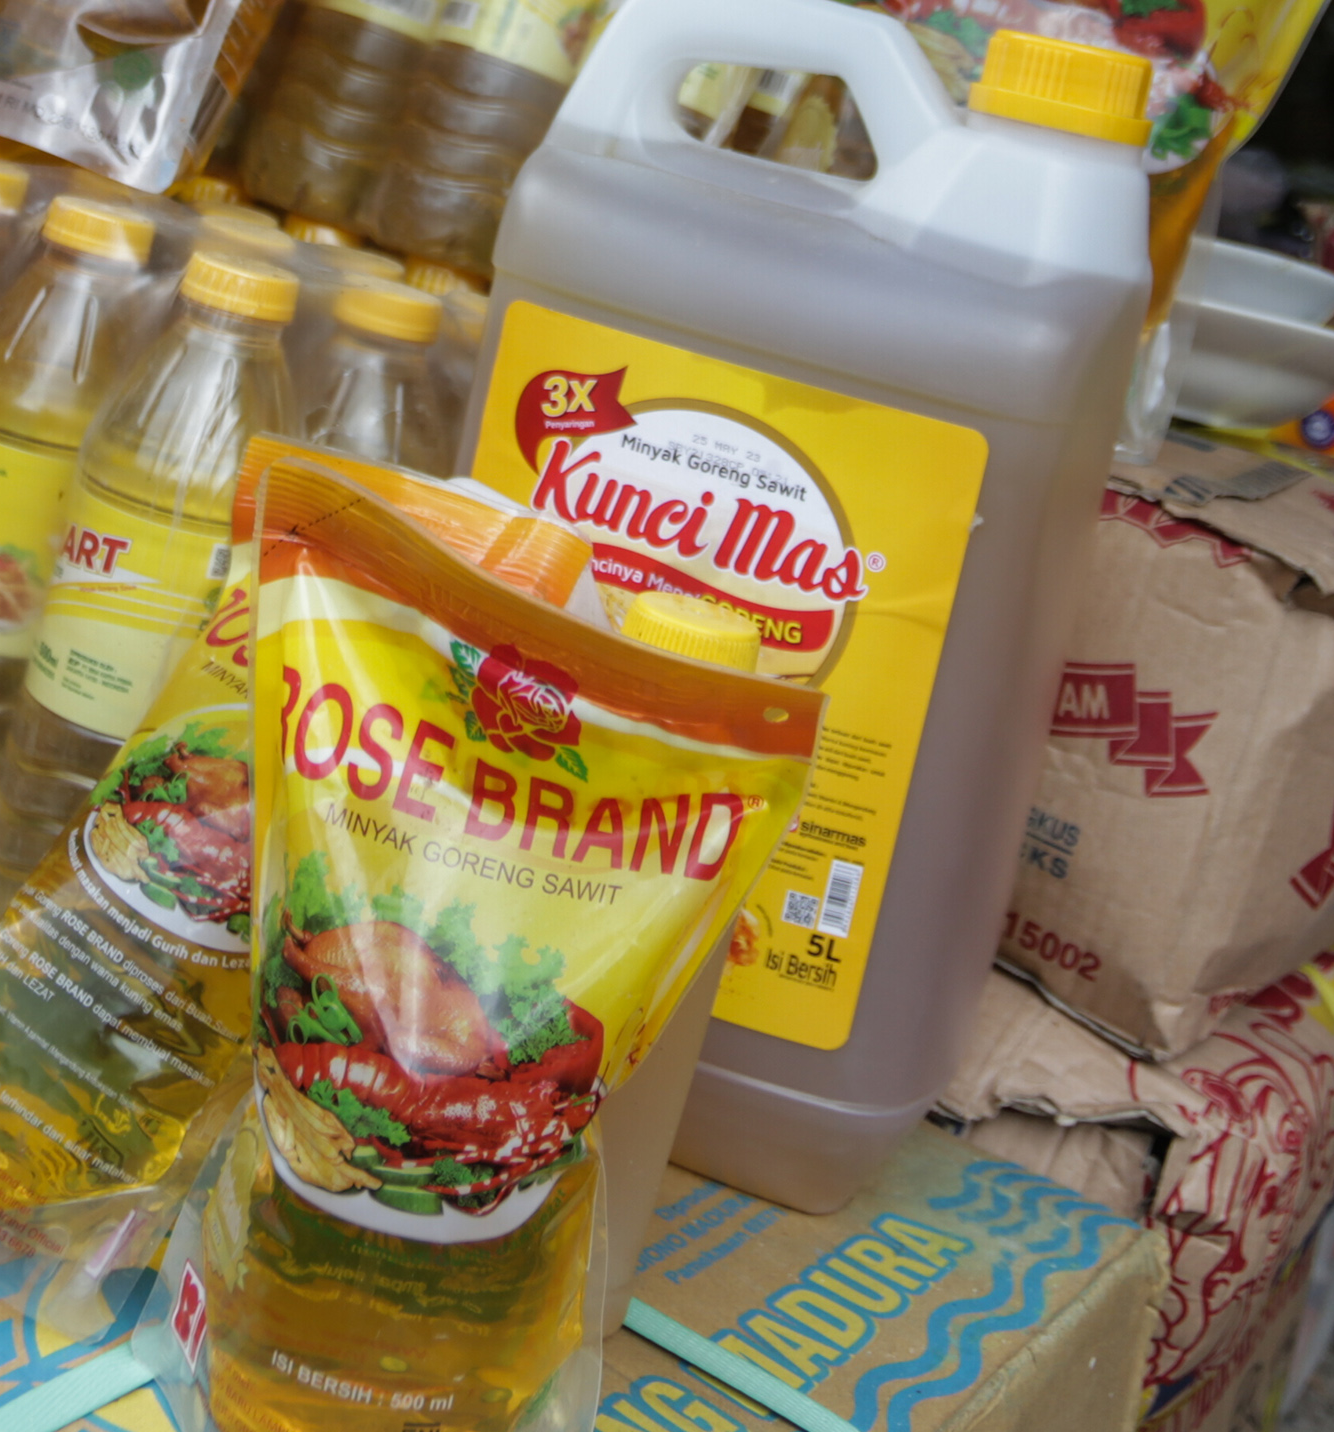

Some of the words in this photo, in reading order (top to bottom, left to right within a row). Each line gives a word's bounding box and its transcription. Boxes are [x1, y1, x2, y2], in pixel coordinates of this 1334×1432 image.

[541, 375, 598, 417] 3X
[544, 418, 596, 431] Penyaringan
[621, 433, 682, 467] Minyak
[687, 453, 751, 488] Goreng
[756, 473, 808, 502] Sawit
[530, 438, 715, 558] Kunci
[713, 497, 870, 604] Mas
[588, 556, 644, 584] ncinya
[324, 803, 415, 855] MINYAK
[423, 837, 535, 890] GORENG
[542, 873, 623, 907] SAWIT
[465, 759, 743, 883] BRAND
[801, 818, 867, 848] sinarmas
[77, 869, 111, 911] masakan
[108, 905, 153, 944] menjadi
[152, 936, 190, 961] Gurih
[191, 951, 219, 968] dan
[807, 934, 843, 964] 5L
[1003, 912, 1102, 984] 15002
[22, 971, 56, 1004] LEZAT
[57, 931, 91, 967] dengan
[89, 954, 121, 988] warna
[118, 975, 154, 1015] kuning
[153, 1005, 184, 1033] emas
[62, 908, 89, 939] ROSE
[85, 928, 124, 965] BRAND
[123, 955, 167, 996] diproses
[165, 986, 187, 1010] dari
[766, 949, 783, 972] Isi
[786, 953, 839, 987] Bersih
[27, 950, 58, 980] ROSE
[55, 973, 95, 1009] BRAND
[92, 1000, 123, 1032] dapat
[121, 1022, 173, 1063] membuat
[169, 1053, 218, 1089] masakan
[0, 1089, 38, 1130] terhindar
[42, 1123, 65, 1145] dari
[65, 1138, 93, 1163] sinar
[91, 1155, 140, 1186] matahari
[26, 1227, 67, 1255] Official
[271, 1350, 294, 1375] ISI
[297, 1365, 372, 1406] BERSIH
[390, 1392, 425, 1412] 500
[429, 1393, 455, 1411] ml
